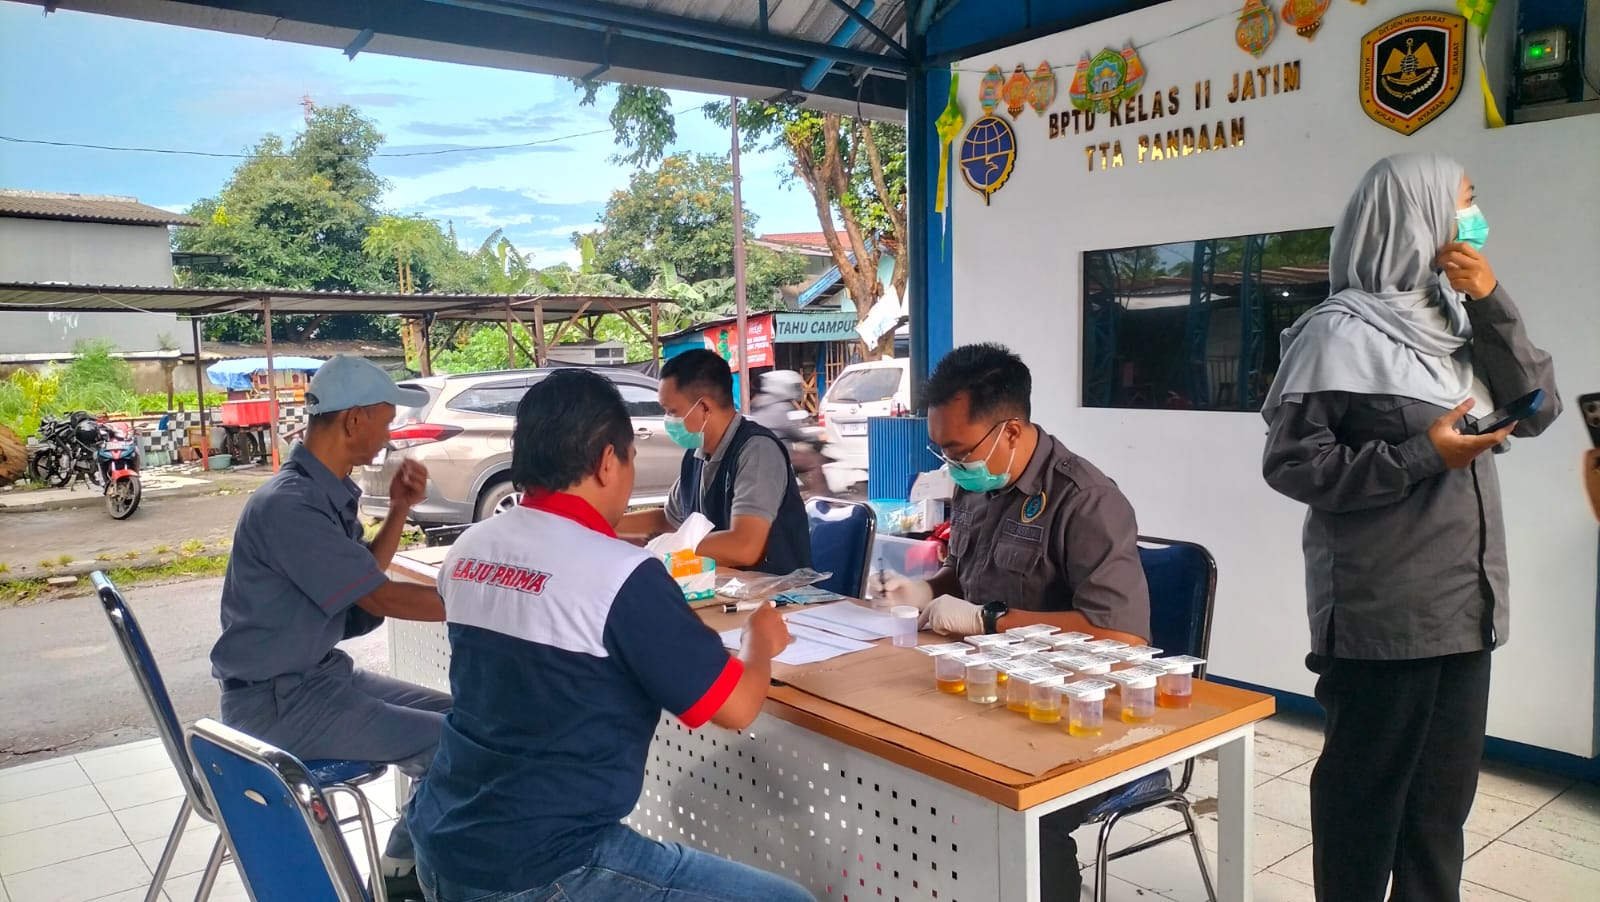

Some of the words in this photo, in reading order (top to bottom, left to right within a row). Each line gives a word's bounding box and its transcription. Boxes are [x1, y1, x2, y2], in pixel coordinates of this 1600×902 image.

[1421, 15, 1446, 23] DARAT
[1049, 109, 1096, 139] BPTD
[1110, 85, 1180, 127] KELAS
[1195, 80, 1210, 110] II
[1228, 60, 1300, 103] JATIM
[1418, 100, 1445, 122] NYAMAN
[1085, 140, 1124, 171] TTA
[1138, 117, 1244, 163] PANDAAN
[779, 321, 808, 335] TAHU
[451, 559, 494, 582] LAJU
[490, 564, 550, 594] PRIMA
